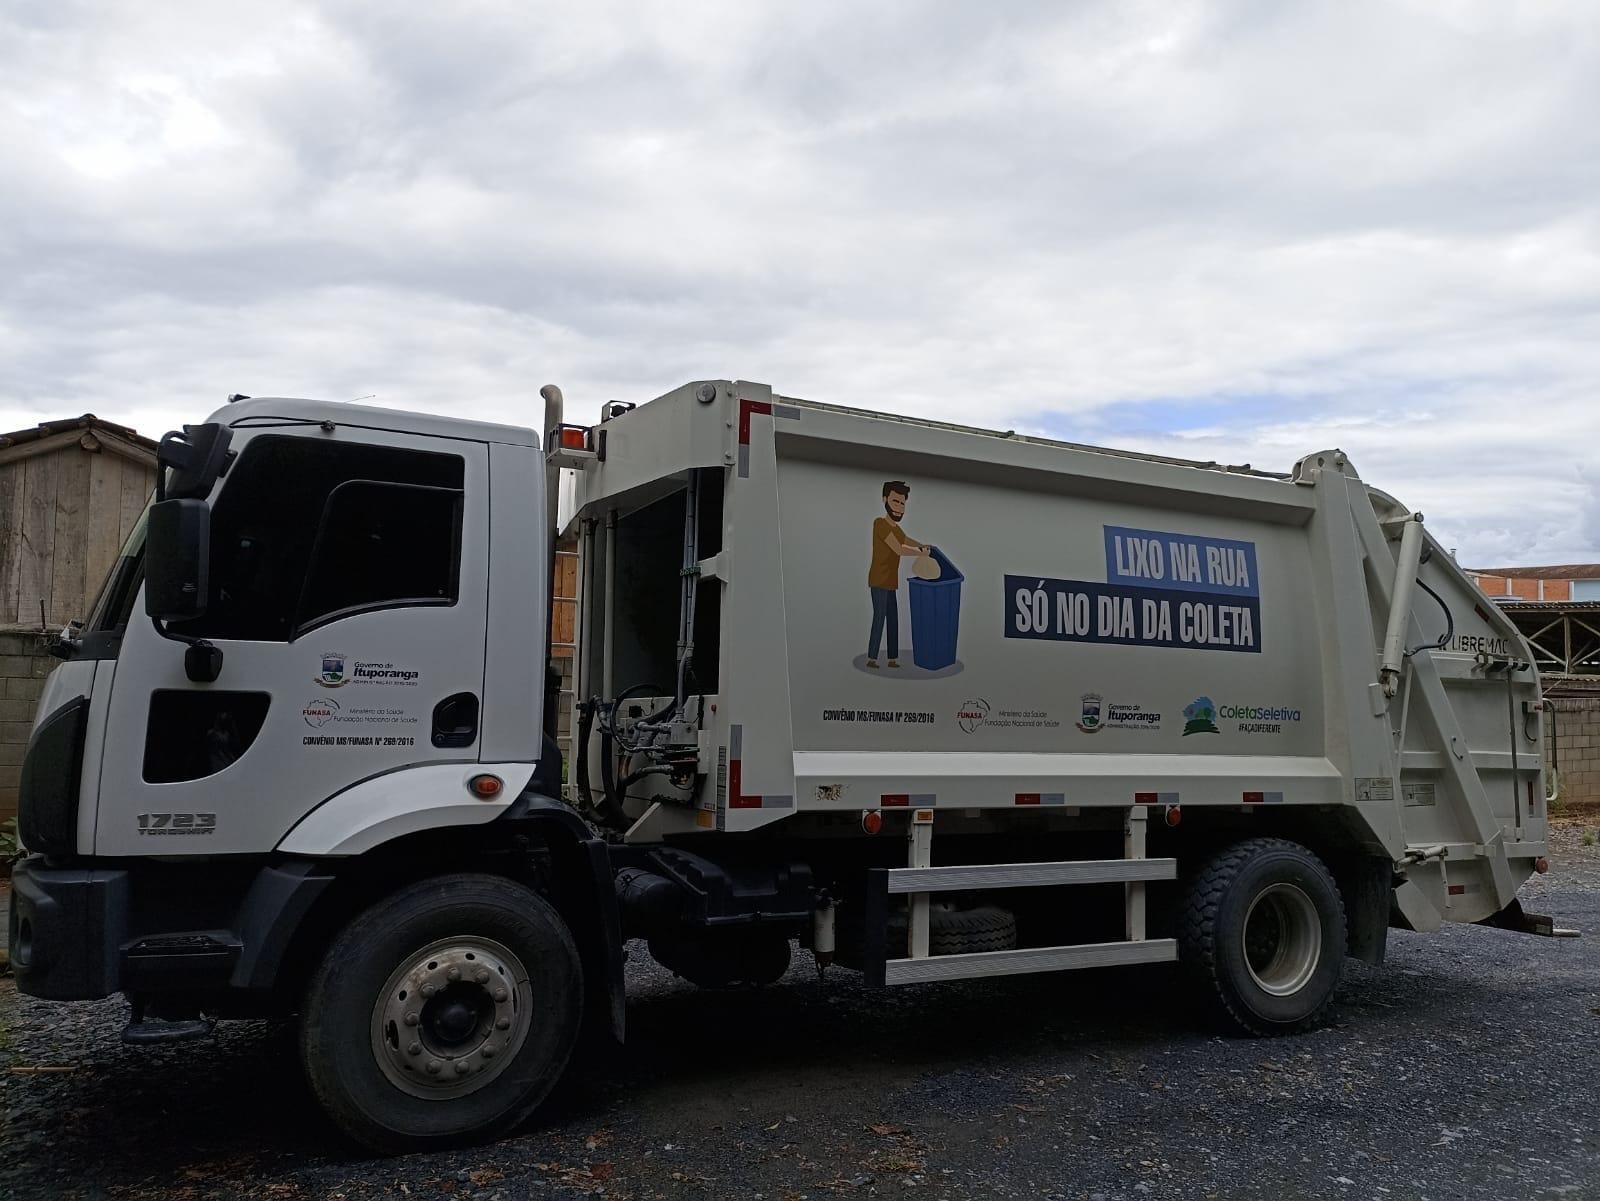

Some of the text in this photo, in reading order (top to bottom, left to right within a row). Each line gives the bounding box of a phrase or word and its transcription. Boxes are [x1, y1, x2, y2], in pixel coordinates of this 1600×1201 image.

[1115, 535, 1249, 588] LIXO NA RUA
[1015, 579, 1253, 646] SÓ NO DIA DA COLETA
[1452, 635, 1508, 654] LIBREMAC
[354, 661, 383, 669] Governo
[353, 668, 419, 680] Ituporanga
[1108, 703, 1132, 711] Governo
[1219, 705, 1301, 721] ColetaSeletiva
[823, 708, 855, 721] CONVÊNIO
[856, 710, 894, 722] MS/FUNASA
[1108, 710, 1161, 723] Ituporanga
[303, 735, 335, 746] CONVÊNIO
[336, 737, 373, 746] MS/FUNASA
[137, 813, 217, 828] 1723
